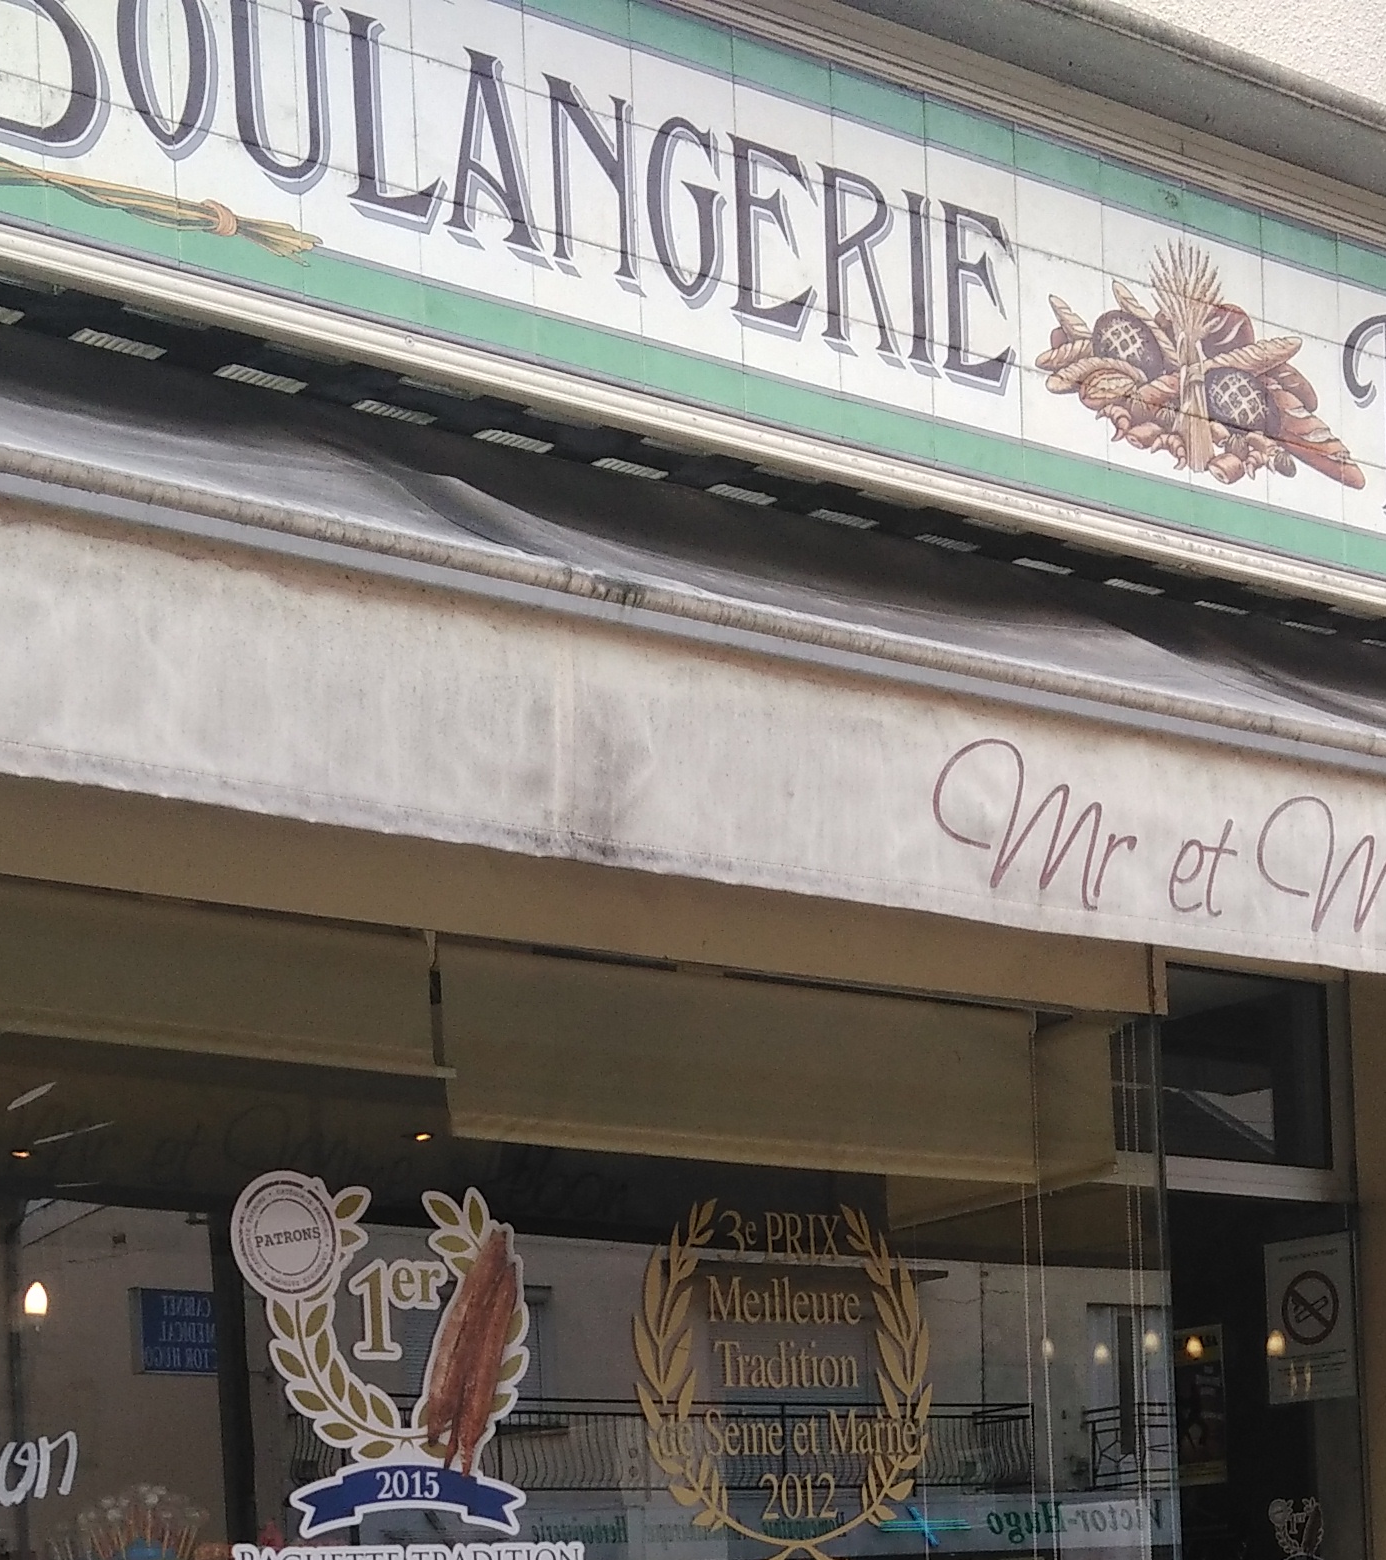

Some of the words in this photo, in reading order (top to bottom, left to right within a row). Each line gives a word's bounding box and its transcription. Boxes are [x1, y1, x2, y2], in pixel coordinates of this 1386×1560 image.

[933, 738, 1135, 912] Mr
[1168, 818, 1239, 917] et
[254, 1226, 321, 1249] PATRONS
[764, 1212, 841, 1261] PRIX
[351, 1261, 442, 1354] 1er
[706, 1275, 862, 1326] Meilleure
[714, 1339, 860, 1389] Tradition
[657, 1414, 694, 1457] de
[704, 1408, 786, 1456] Seine
[791, 1415, 820, 1455] et
[827, 1408, 918, 1456] Marne
[375, 1470, 440, 1501] 2015
[758, 1471, 840, 1520] 2012
